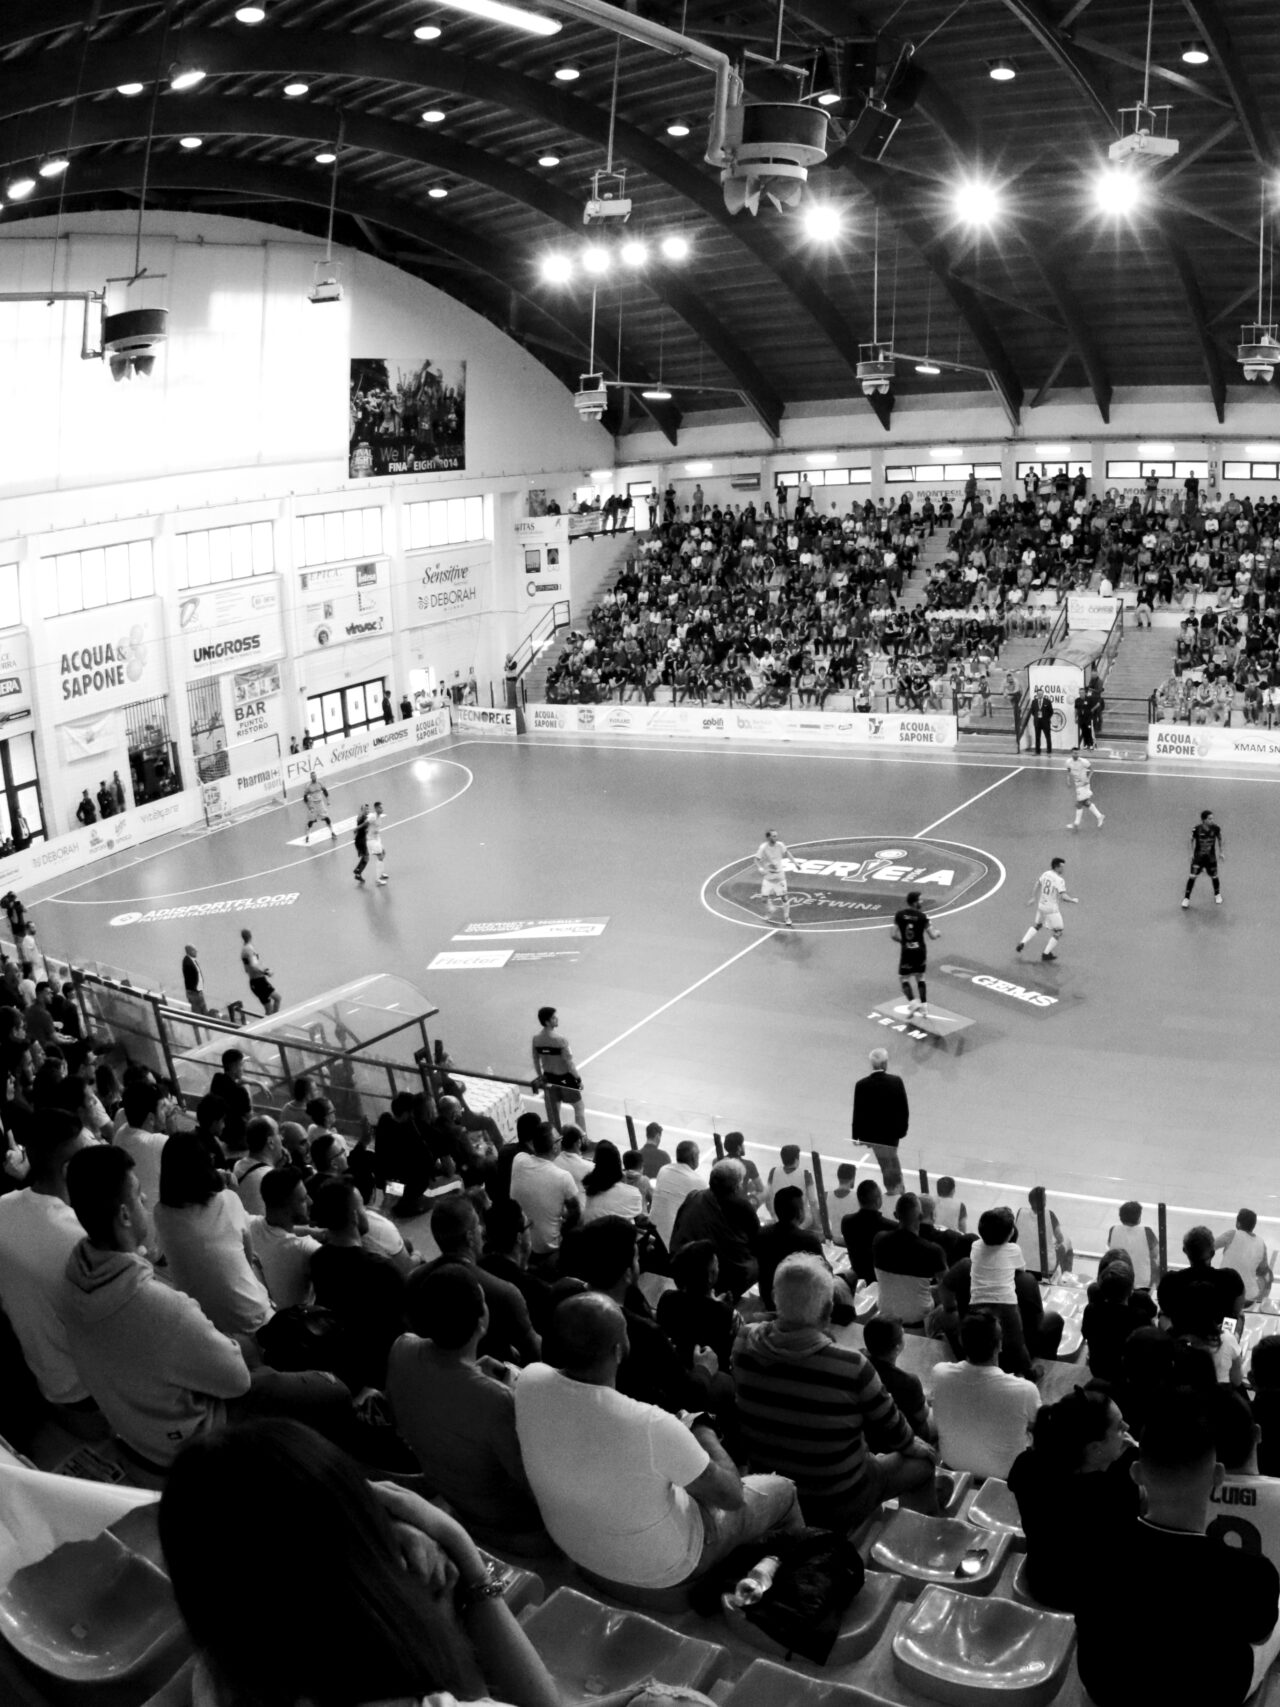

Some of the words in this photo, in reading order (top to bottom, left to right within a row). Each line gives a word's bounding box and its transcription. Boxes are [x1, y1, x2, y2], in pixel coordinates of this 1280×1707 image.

[388, 461, 408, 473] FINA
[439, 457, 459, 469] 014
[421, 562, 470, 587] Sensitive
[430, 586, 477, 608] DEBORAH
[60, 642, 116, 677] ACQUA
[61, 664, 126, 701] SAPONE
[233, 700, 268, 722] BAR
[534, 710, 555, 720] ACQUA
[236, 722, 270, 738] RISTORO
[238, 715, 266, 729] PUNTO
[415, 717, 437, 732] ACQUA
[900, 720, 929, 732] ACQUA
[415, 727, 439, 742] SAPONE
[899, 732, 935, 743] SAPONE
[1156, 732, 1192, 744] ACQUA
[330, 743, 370, 766] Sensitive
[1156, 743, 1196, 756] SAPONE
[913, 868, 956, 887] A
[142, 892, 300, 919] ADISPORTFLOOR
[970, 974, 1060, 1009] GEMS
[866, 1010, 929, 1041] TEAM
